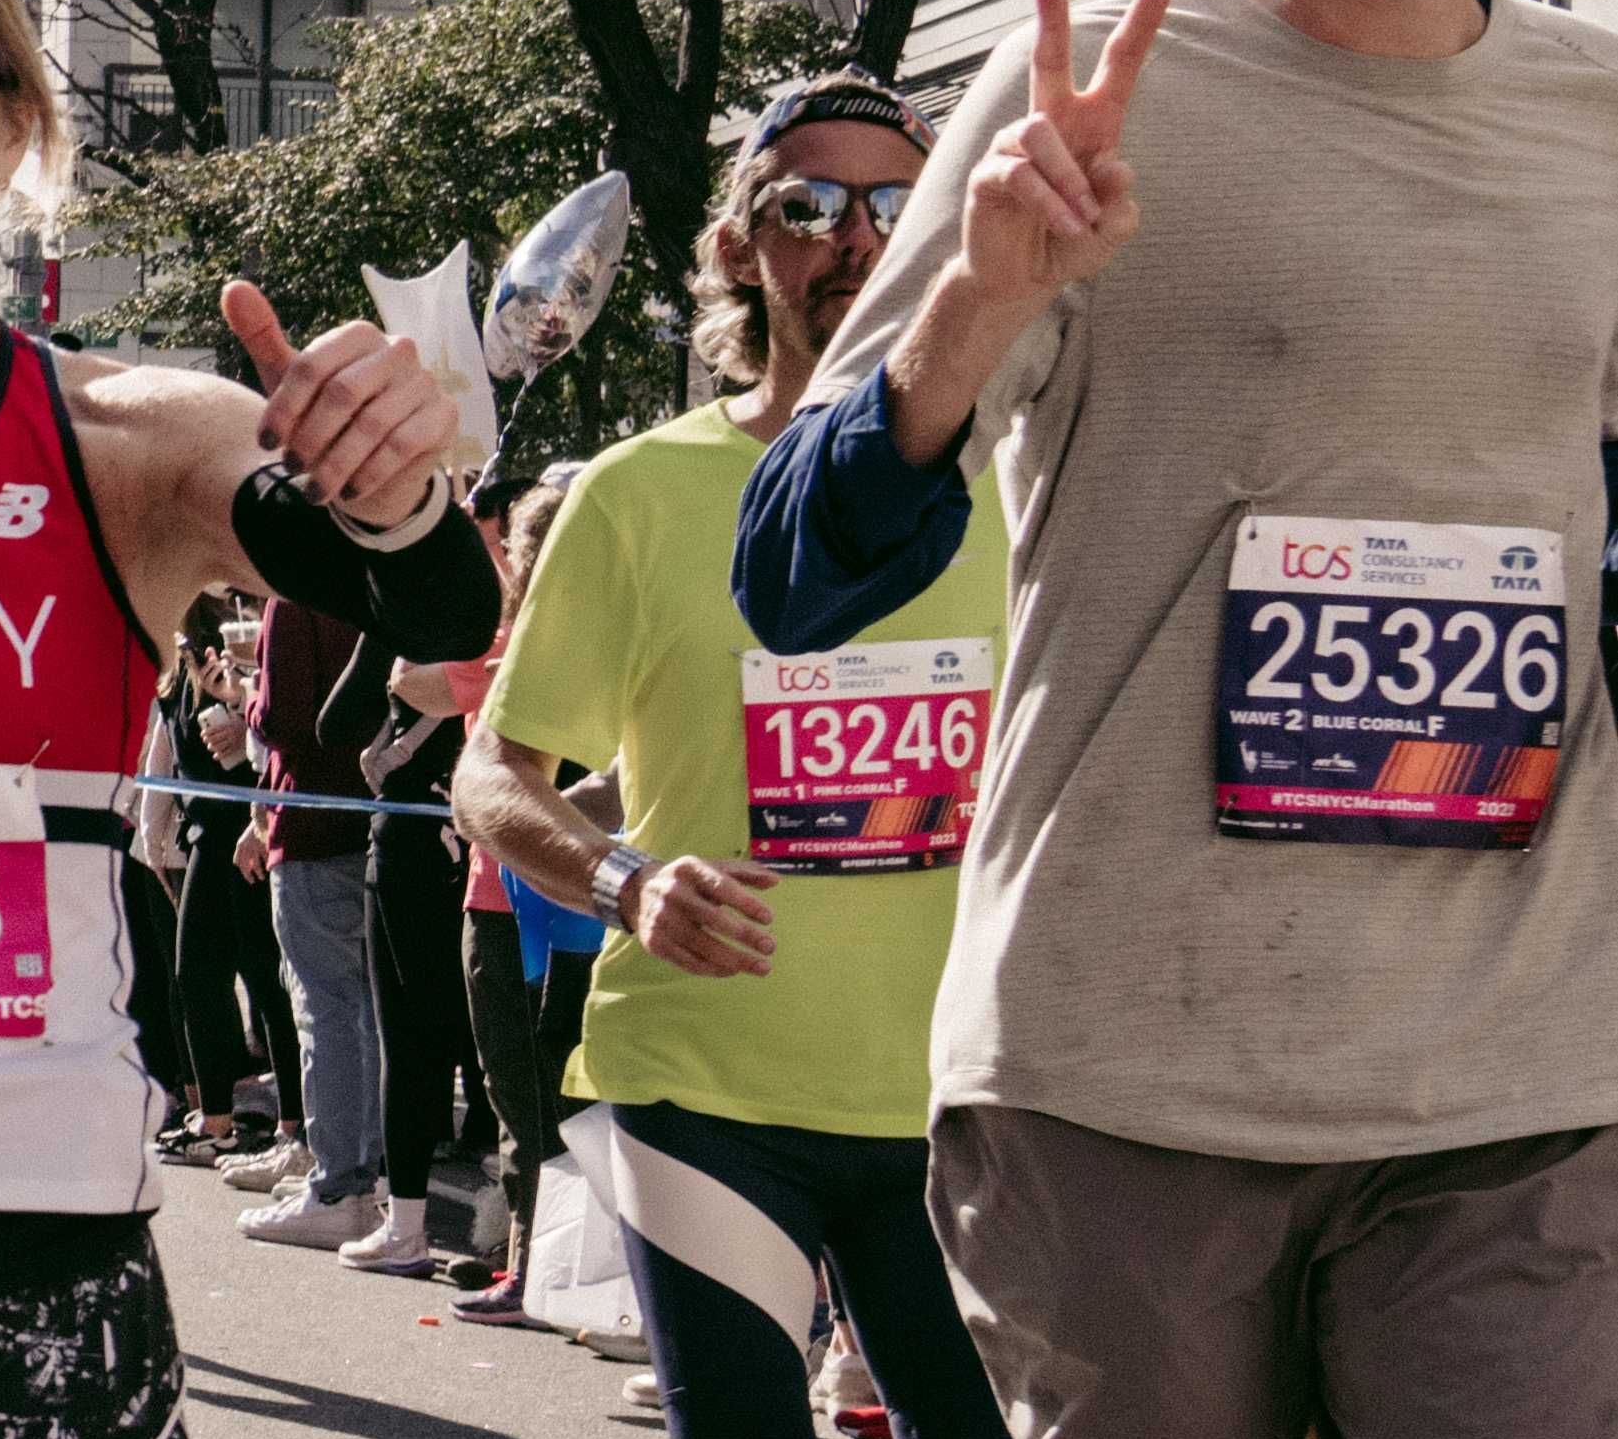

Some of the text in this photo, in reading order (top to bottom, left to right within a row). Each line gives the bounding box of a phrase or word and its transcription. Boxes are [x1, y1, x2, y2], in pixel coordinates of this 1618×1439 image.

[1363, 537, 1409, 552] TATA
[1281, 535, 1354, 581] tcs
[1361, 553, 1466, 571] CONSULTANCY
[1360, 571, 1427, 586] SERVICES
[1490, 575, 1542, 592] TATA
[836, 656, 868, 666] TATA
[1246, 601, 1560, 713] 25326
[777, 663, 831, 692] tcs
[836, 665, 912, 677] CONSULTANCY
[930, 672, 965, 684] TATA
[836, 678, 886, 690] SERVICES
[1229, 709, 1446, 737] WAVE 2 BLUE CORRAL F
[765, 698, 977, 778] 13246
[753, 778, 909, 801] WAVE 1 PINK CORRAL F
[1271, 793, 1435, 813] #TCSNYCMarathon
[929, 832, 957, 846] 2023
